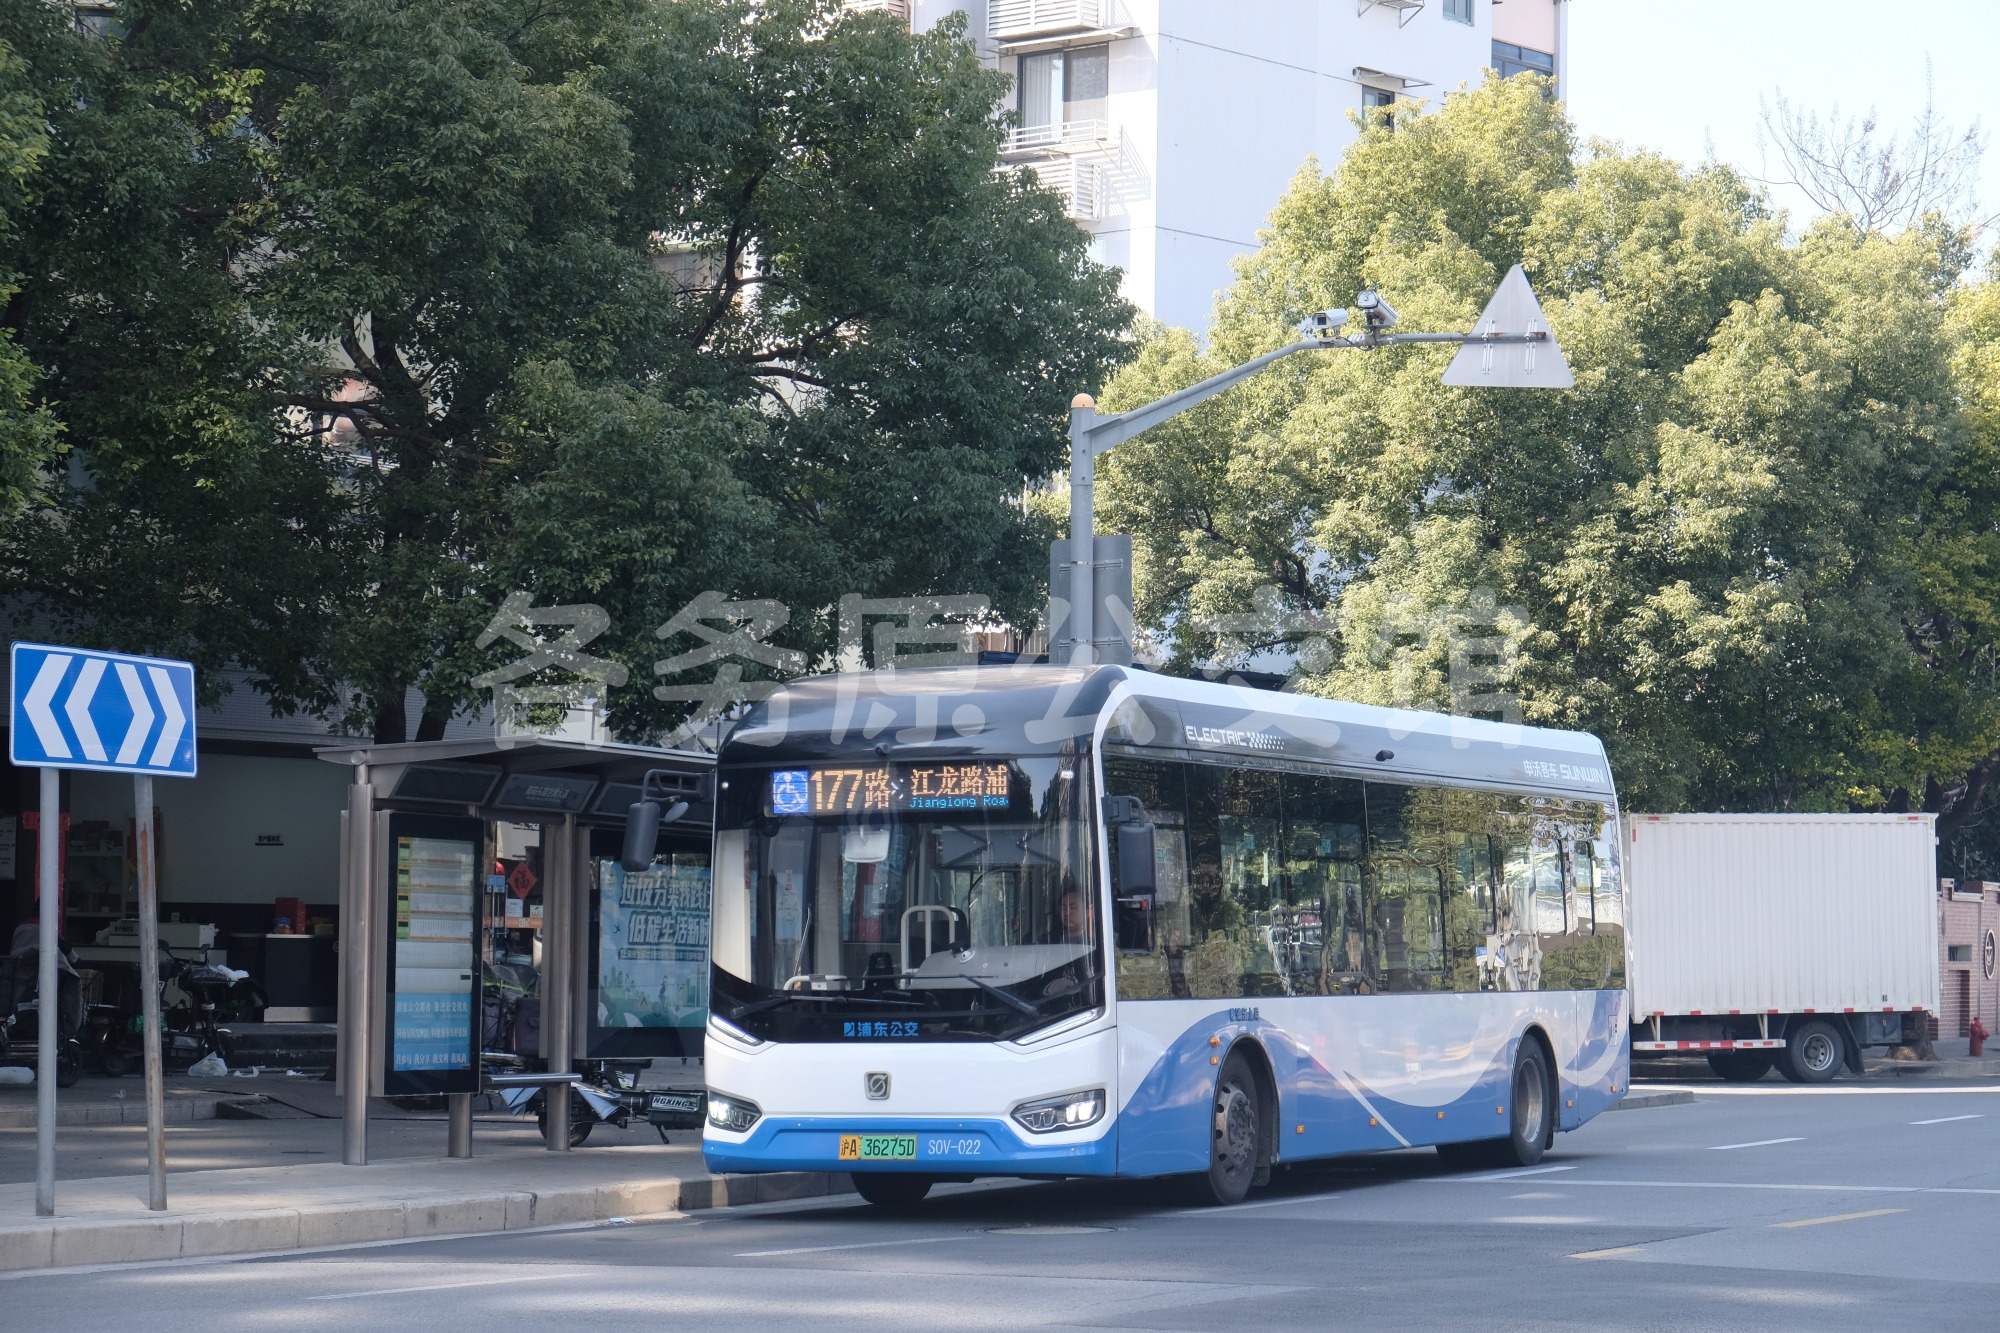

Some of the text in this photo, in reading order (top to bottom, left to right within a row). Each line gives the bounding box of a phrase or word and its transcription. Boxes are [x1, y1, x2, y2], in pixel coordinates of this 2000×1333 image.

[1185, 725, 1247, 746] ELECTRIC
[1523, 759, 1605, 784] 申沃客车 SUNWIN
[810, 765, 1008, 810] 177路 江龙路浦
[910, 795, 1009, 809] Jianglong Roa
[857, 1022, 918, 1037] 浦东公交
